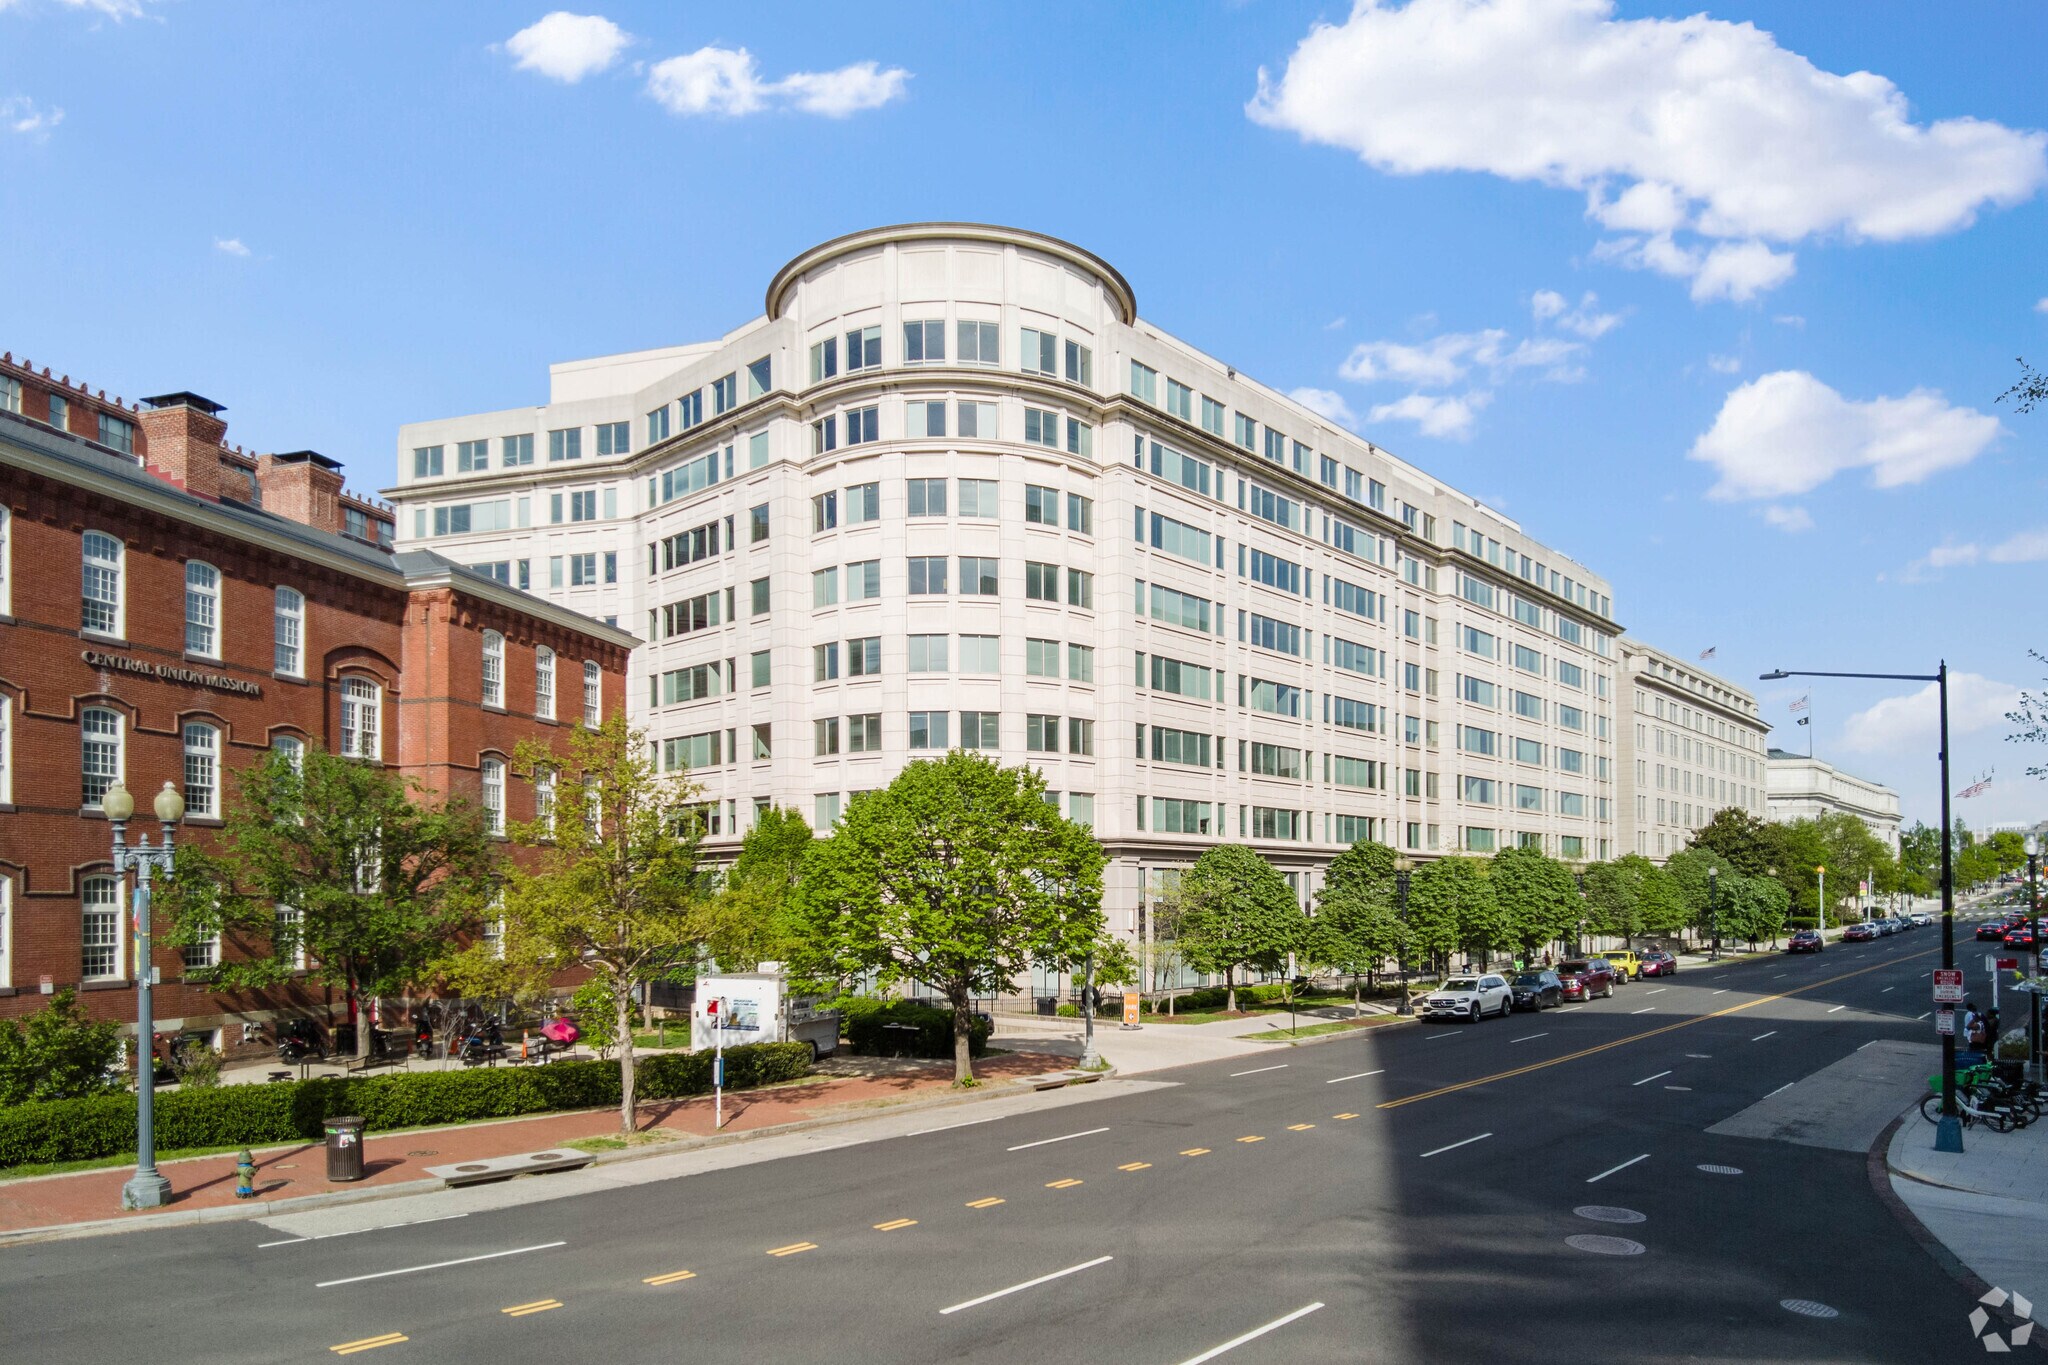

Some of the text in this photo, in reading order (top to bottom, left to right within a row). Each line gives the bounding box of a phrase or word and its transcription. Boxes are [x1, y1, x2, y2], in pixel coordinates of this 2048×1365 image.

[81, 650, 260, 695] CENTRAL UNION MISSION
